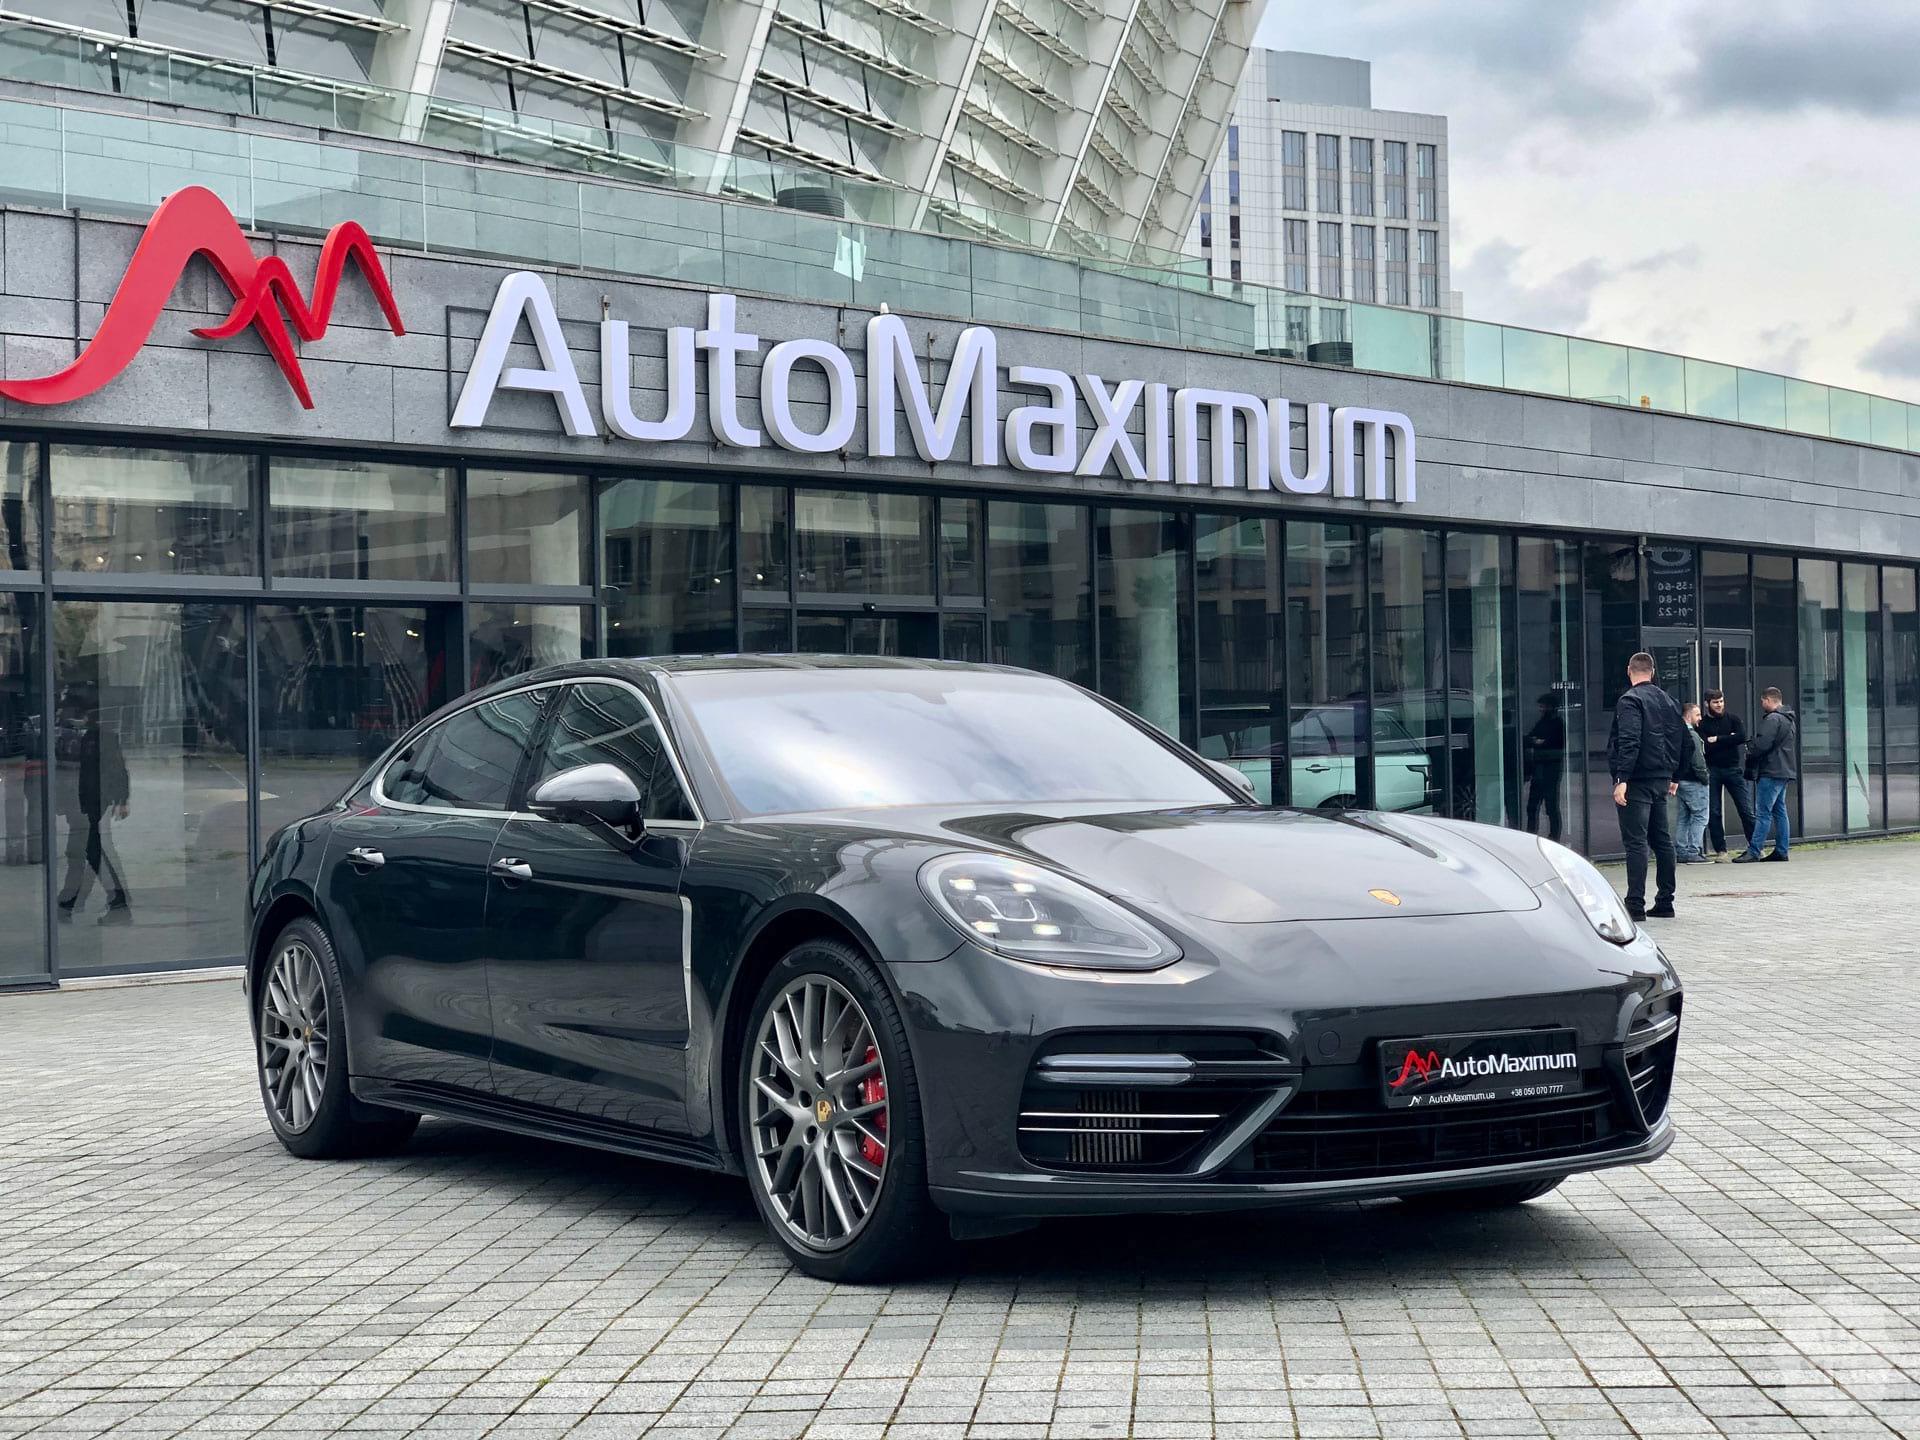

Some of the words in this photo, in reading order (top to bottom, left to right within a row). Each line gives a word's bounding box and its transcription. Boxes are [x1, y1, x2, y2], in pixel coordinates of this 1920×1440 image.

[450, 271, 1416, 504] AutoMaximum
[1440, 1052, 1577, 1078] AutoMaximum
[1428, 1091, 1496, 1105] AutoMaximum.ua
[1511, 1088, 1523, 1097] +38
[1523, 1087, 1535, 1096] 050
[1536, 1086, 1548, 1095] 070
[1549, 1084, 1564, 1094] 7777
